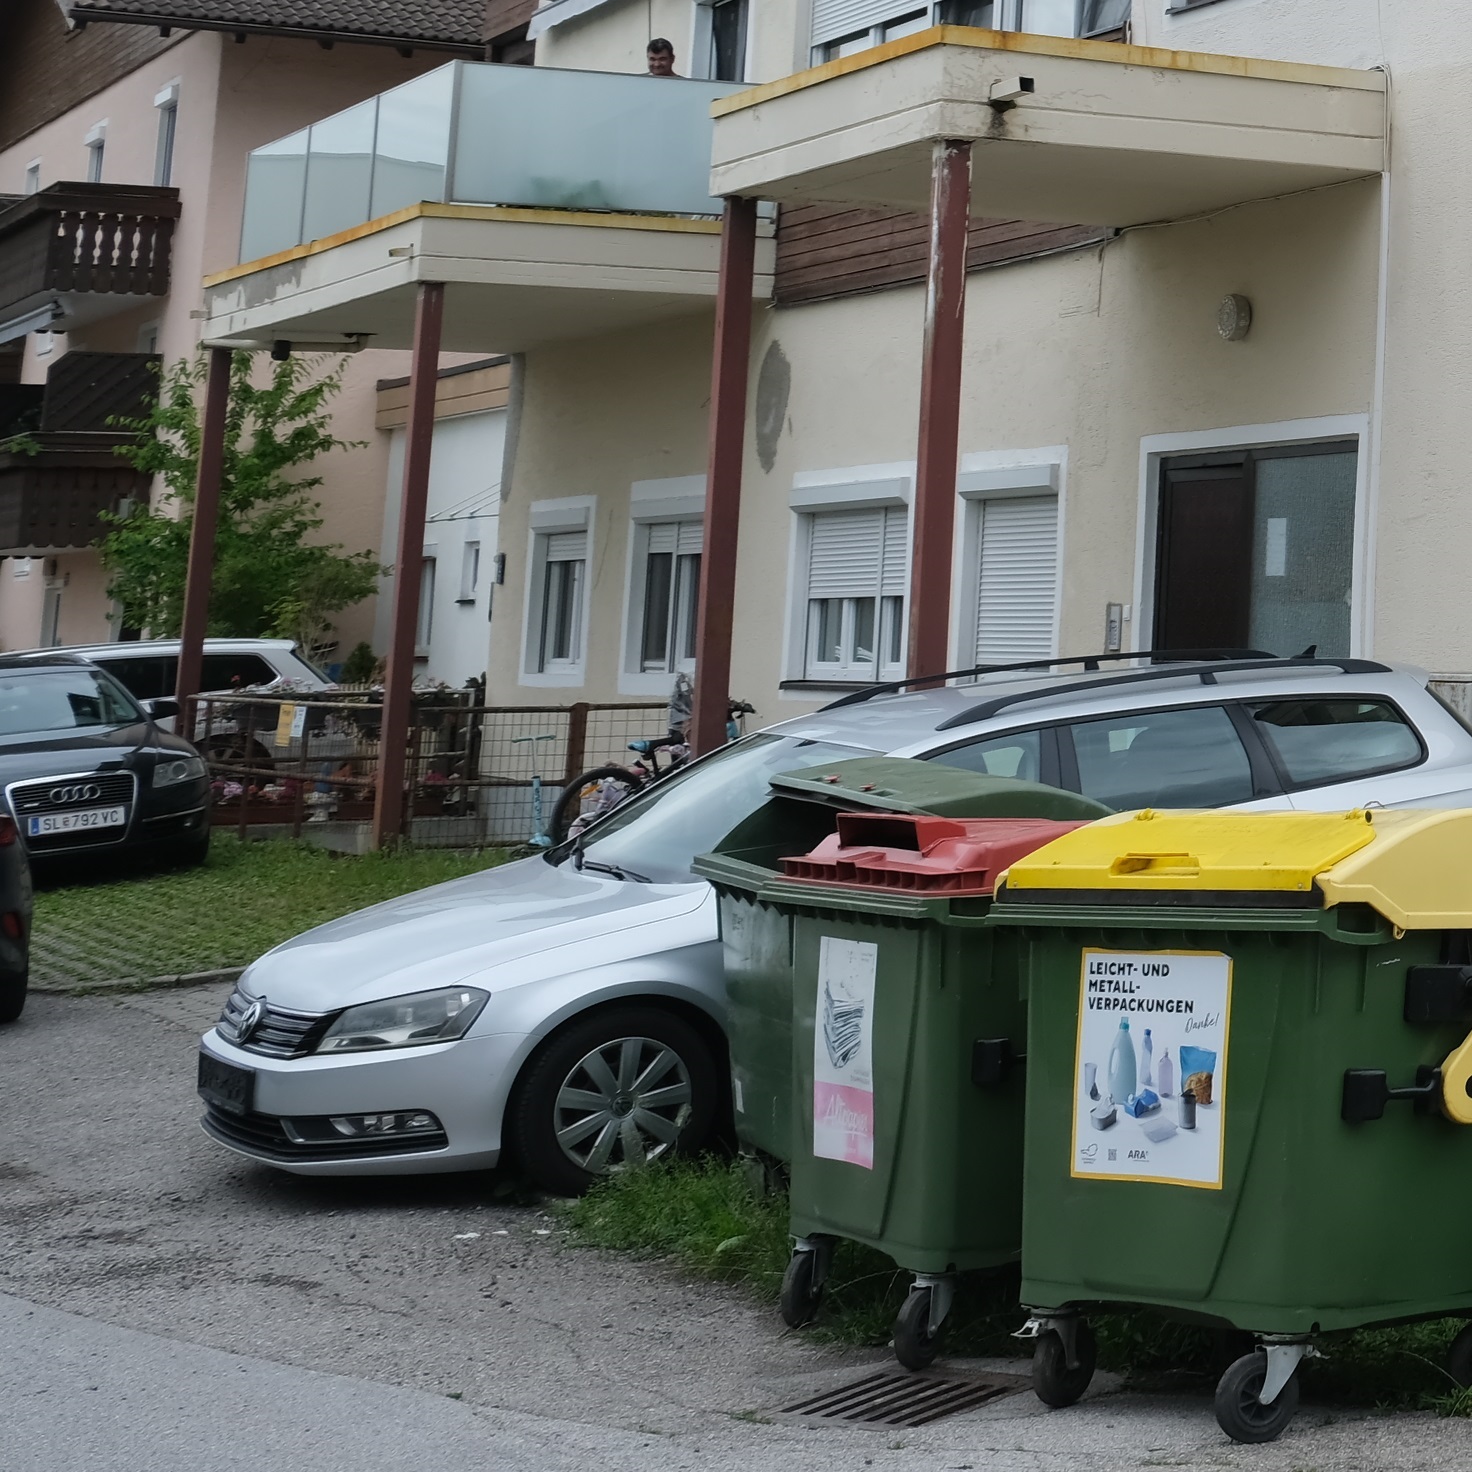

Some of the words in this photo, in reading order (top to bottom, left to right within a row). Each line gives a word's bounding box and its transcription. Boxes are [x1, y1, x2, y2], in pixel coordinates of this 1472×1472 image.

[1089, 962, 1138, 976] LEICHT-
[1142, 963, 1170, 976] UND
[1088, 979, 1141, 994] METALL-
[1088, 997, 1194, 1014] VERPACKUNGEN
[1185, 1012, 1220, 1033] Danke!
[1127, 1149, 1147, 1160] ARA
